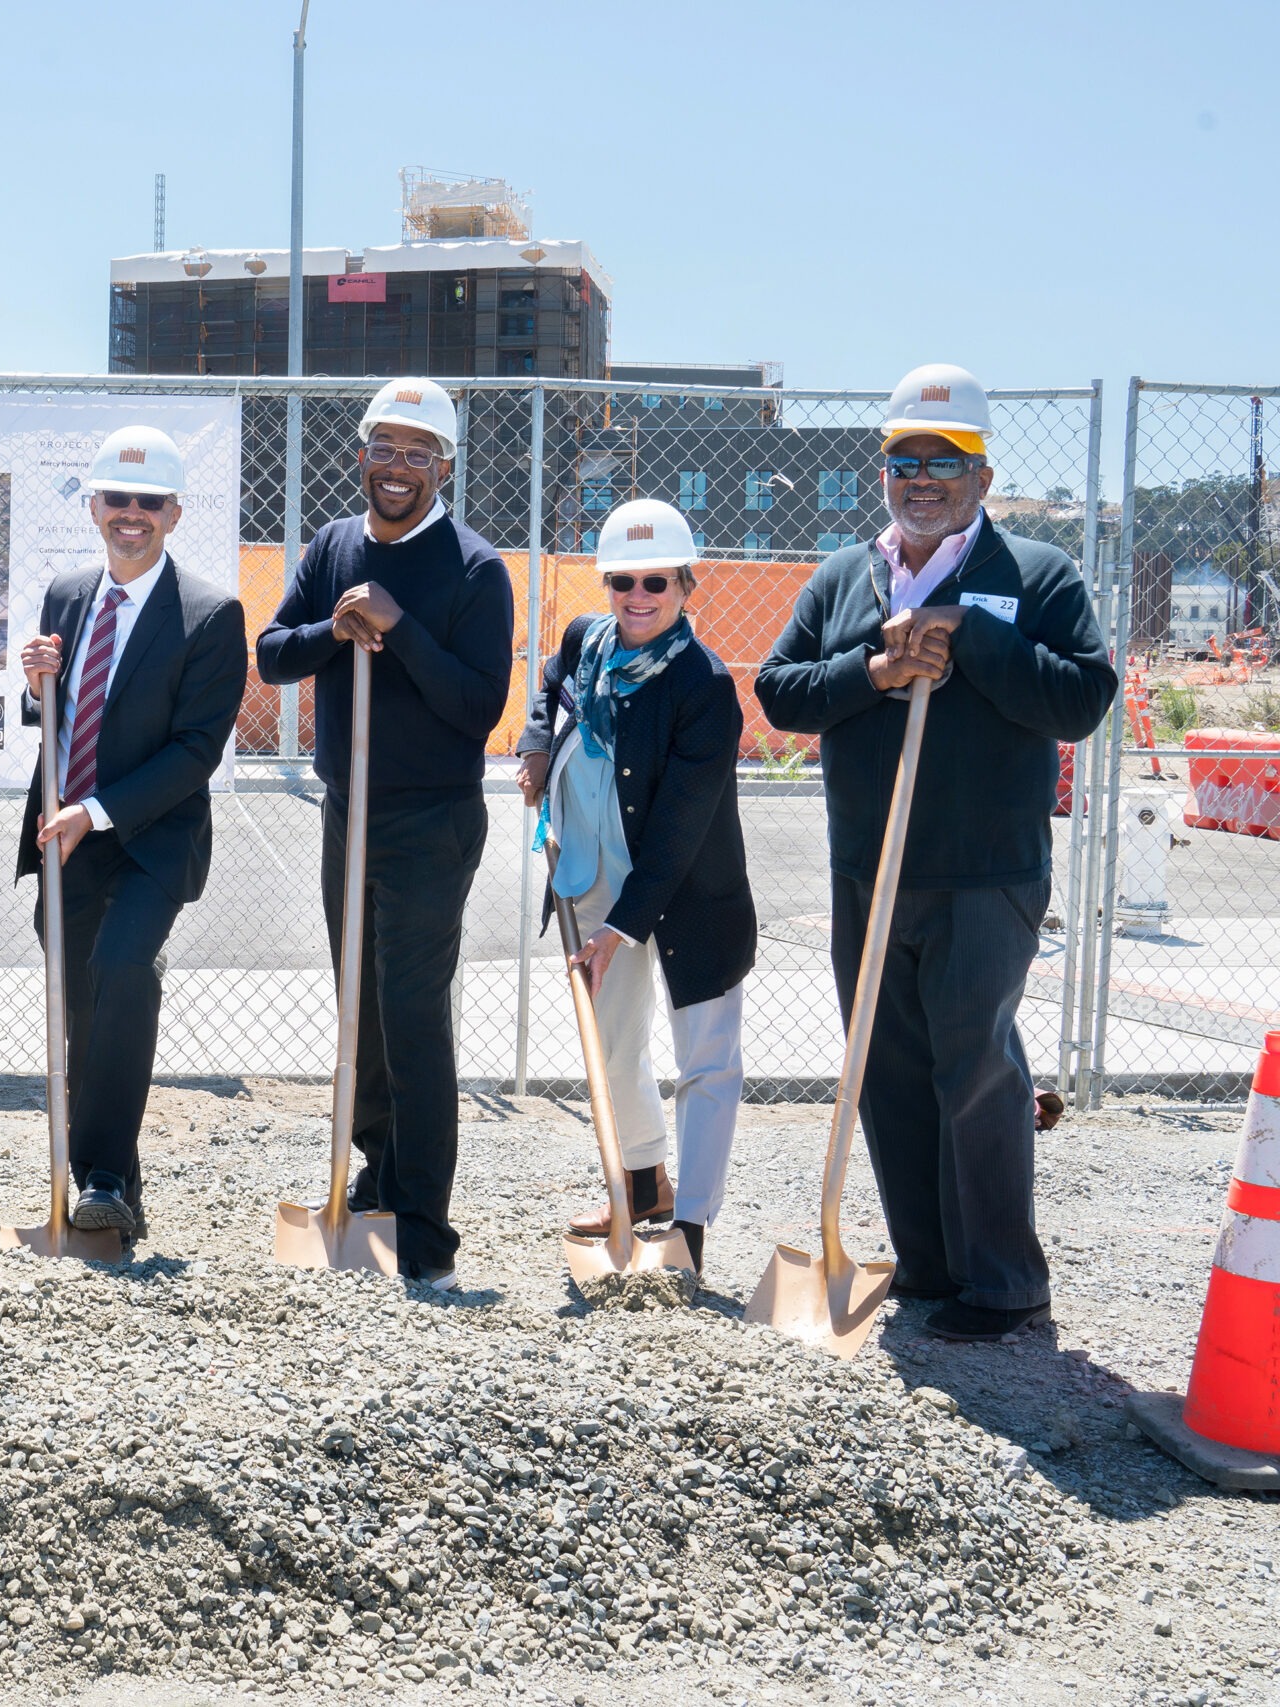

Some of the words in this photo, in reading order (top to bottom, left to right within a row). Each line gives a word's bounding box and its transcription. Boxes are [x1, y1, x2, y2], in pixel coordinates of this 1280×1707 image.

[395, 390, 423, 406] nibbi
[920, 385, 950, 402] nibbi
[40, 441, 89, 449] PROJECT
[119, 447, 146, 464] nibbi
[40, 460, 60, 468] Mercy
[627, 524, 653, 541] nibbi
[1000, 600, 1015, 611] 22
